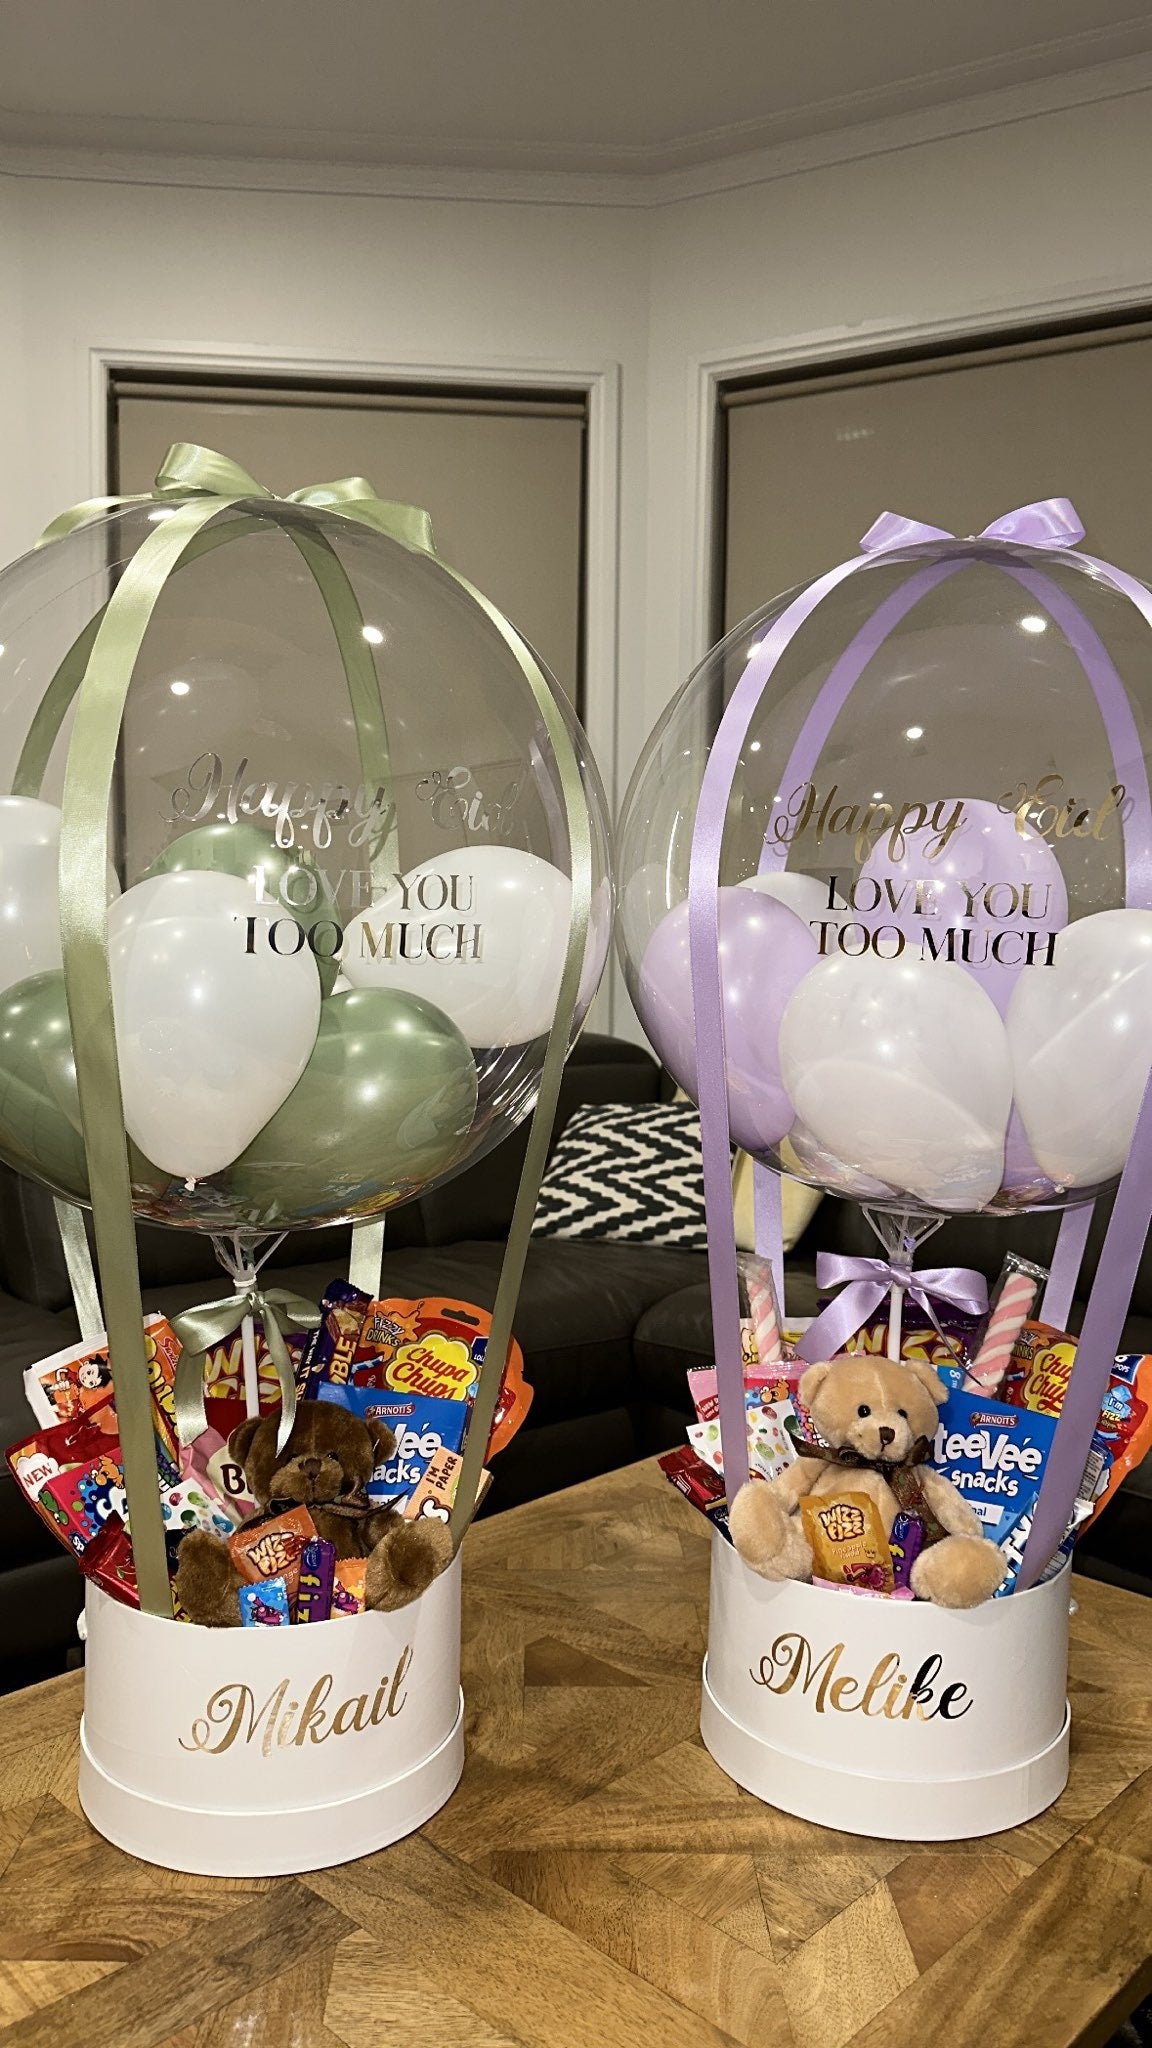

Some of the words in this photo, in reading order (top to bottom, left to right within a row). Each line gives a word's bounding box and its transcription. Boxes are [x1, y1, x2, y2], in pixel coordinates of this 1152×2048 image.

[158, 752, 392, 849] Happy
[415, 766, 524, 833] Eid
[765, 782, 967, 864] Happy
[996, 774, 1126, 841] Eid
[252, 865, 376, 907] LOVE
[393, 873, 474, 911] YOU
[826, 875, 940, 915] LOVE
[958, 882, 1052, 919] YOU
[233, 916, 343, 955] TOO
[361, 921, 481, 959] MUCH
[809, 920, 906, 959] TOO
[919, 927, 1059, 966] MUCH
[374, 1316, 405, 1336] FIZZY
[406, 1347, 470, 1382] Chupa
[22, 1463, 53, 1488] NEW
[368, 1459, 420, 1484] acks
[425, 1465, 441, 1485] I'M
[436, 1456, 458, 1491] PAPER
[951, 1469, 1018, 1497] snacks
[818, 1504, 865, 1526] WIZZ
[826, 1520, 866, 1541] FIZZ
[298, 1574, 321, 1623] fiz
[750, 1632, 973, 1721] Melike
[178, 1644, 413, 1757] Mikail
